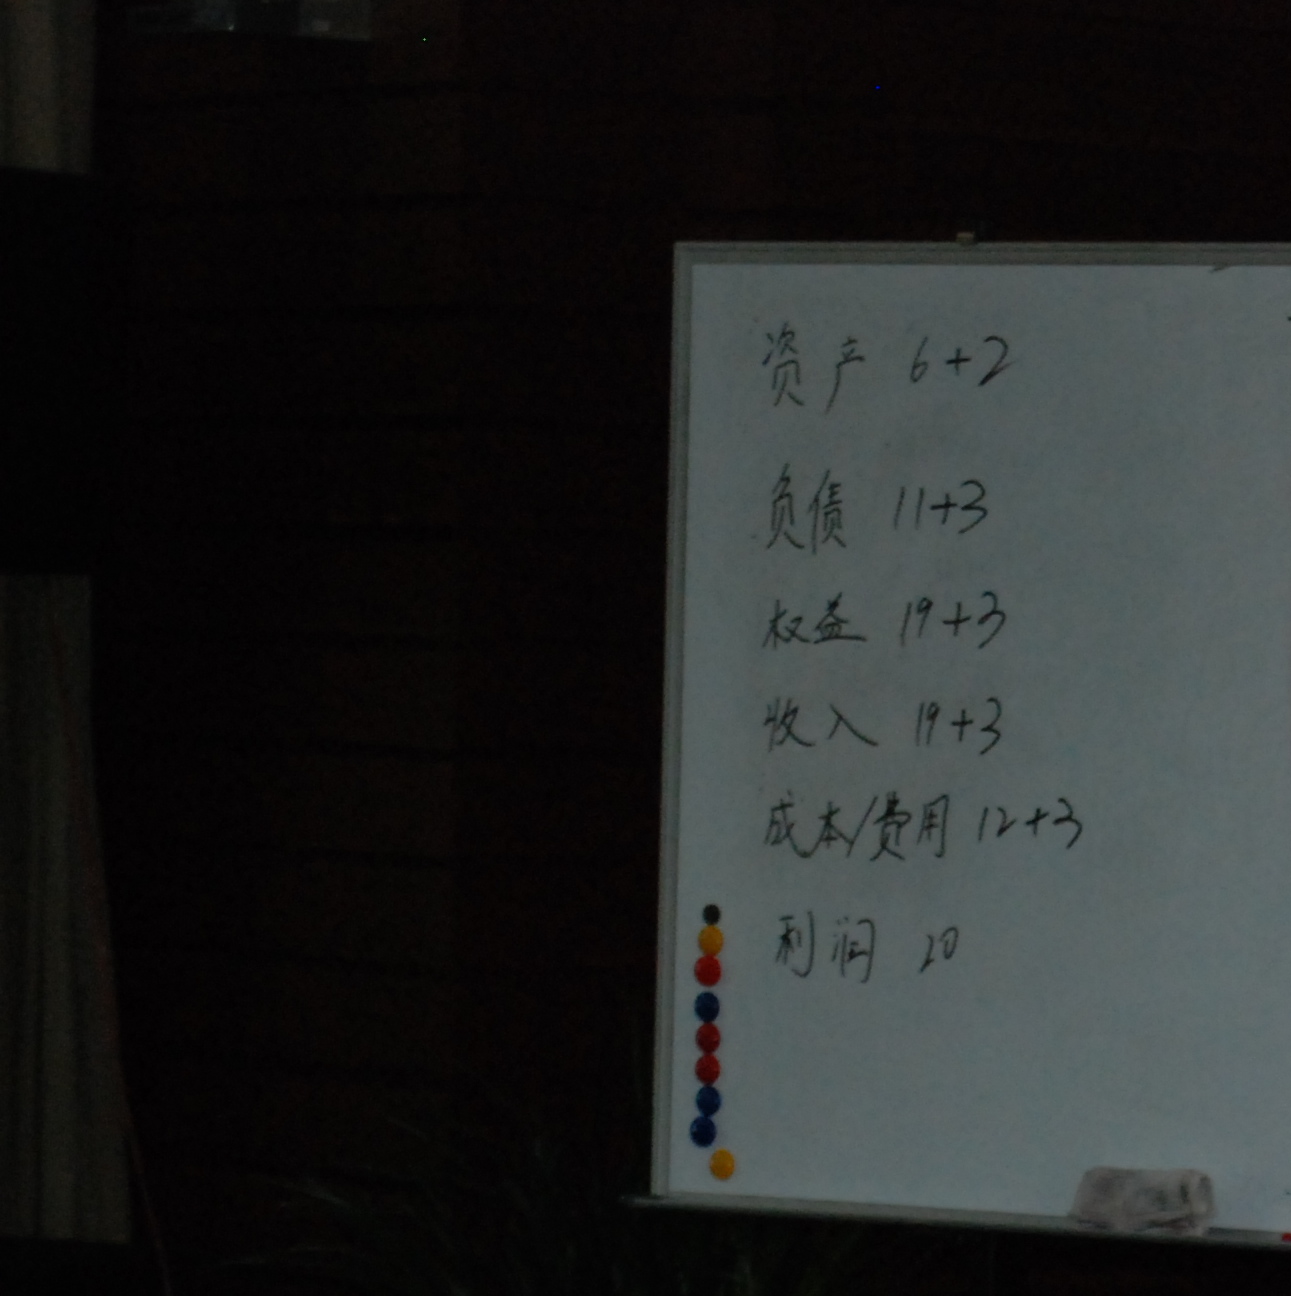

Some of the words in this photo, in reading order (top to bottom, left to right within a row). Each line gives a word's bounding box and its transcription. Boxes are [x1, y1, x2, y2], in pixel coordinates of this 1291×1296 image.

[762, 321, 866, 412] 资产
[909, 335, 1013, 387] 6+2
[765, 463, 848, 551] 负债
[892, 479, 989, 534] 11+3
[762, 592, 867, 651] 权益
[900, 591, 1008, 649] 19+3
[764, 698, 878, 748] 收入
[915, 697, 1003, 755] 19+3
[762, 792, 950, 862] 成本/费用
[978, 798, 1083, 848] 12+3
[775, 911, 876, 984] 利润
[920, 927, 960, 972] 20
